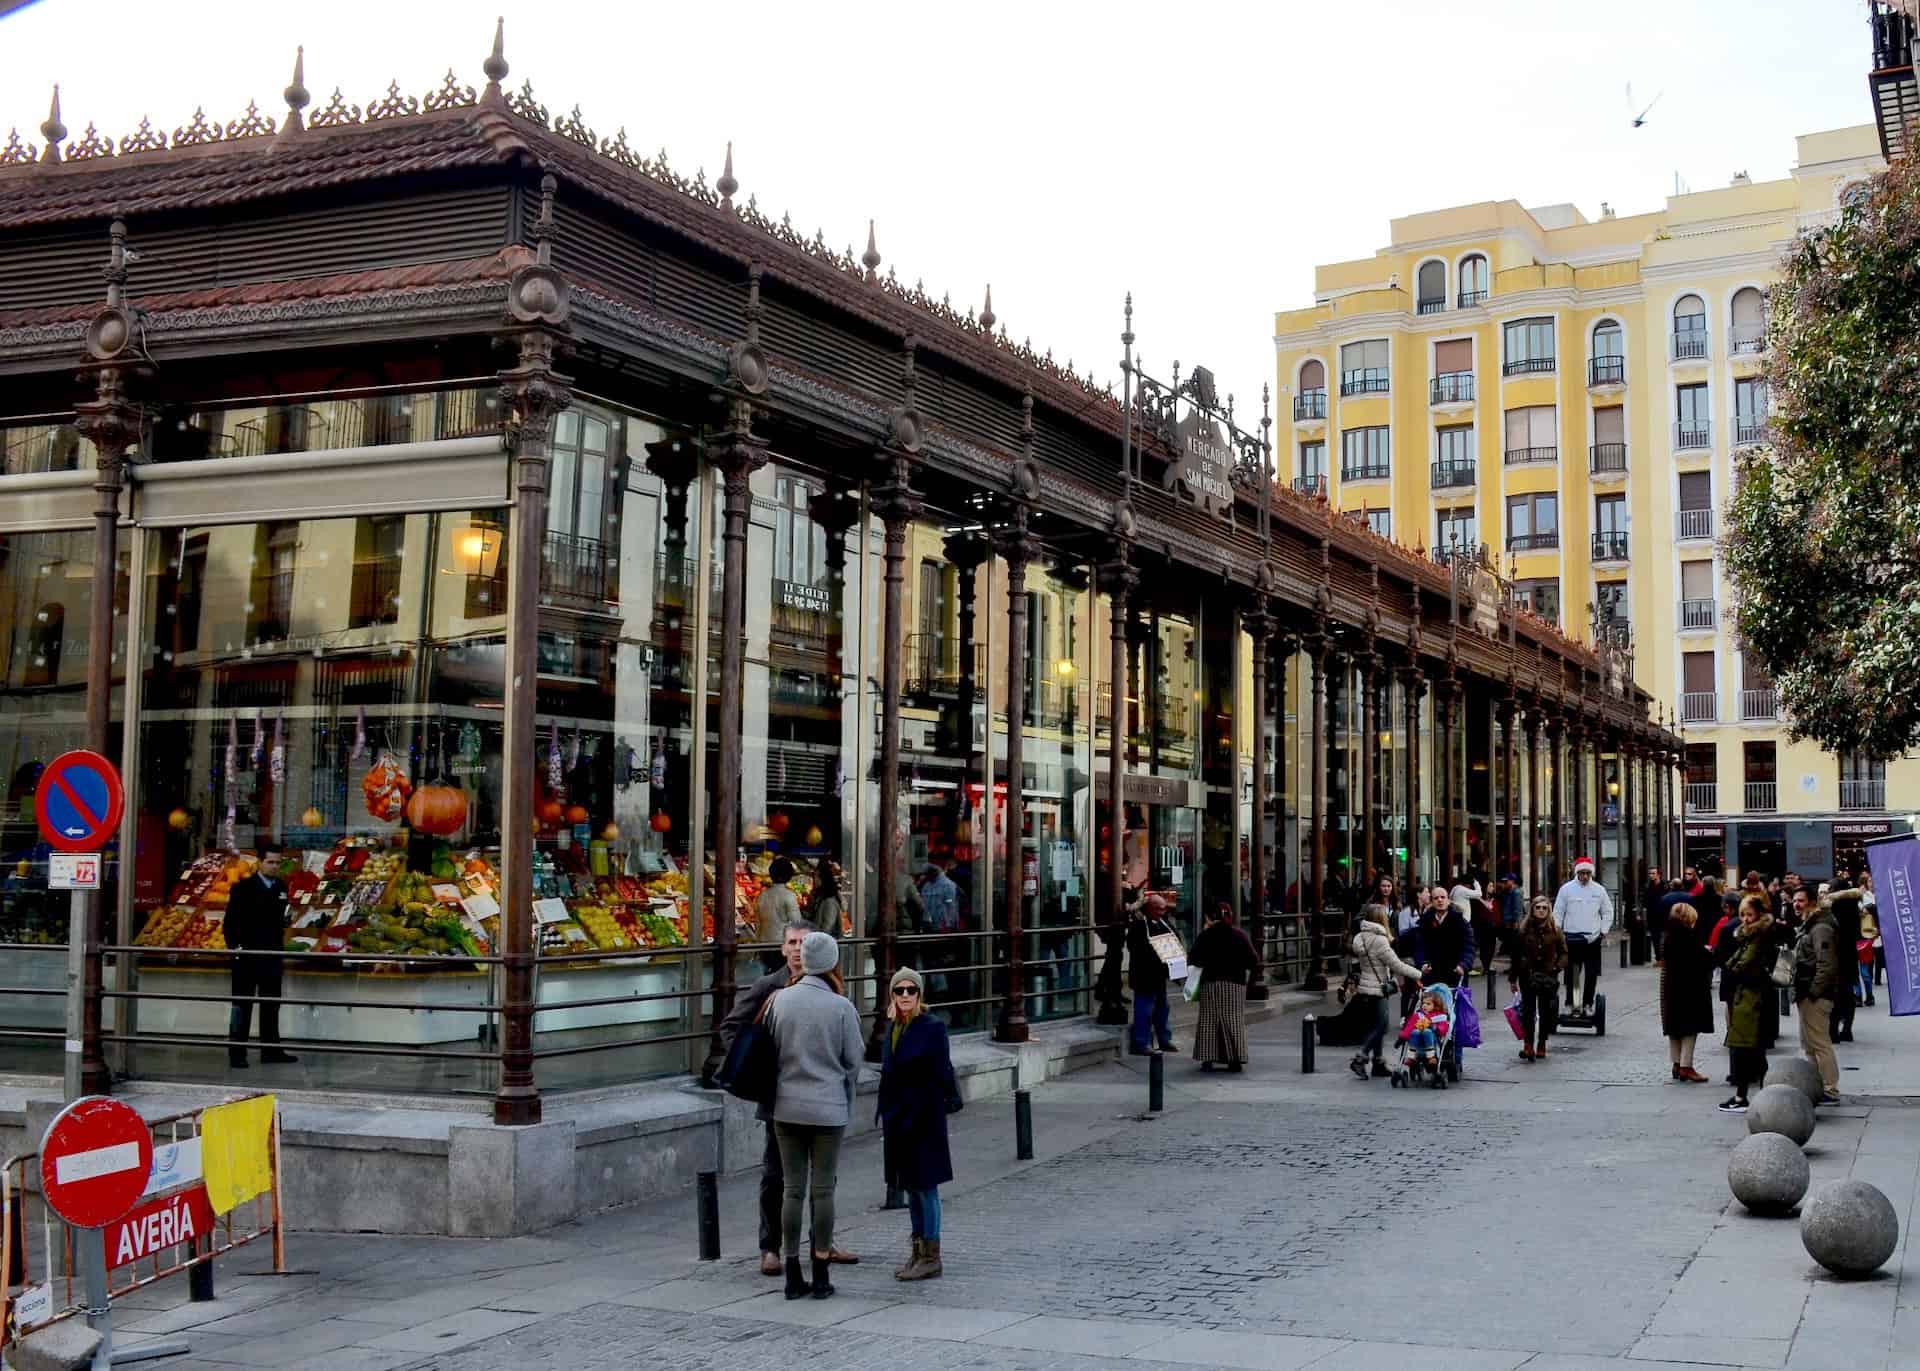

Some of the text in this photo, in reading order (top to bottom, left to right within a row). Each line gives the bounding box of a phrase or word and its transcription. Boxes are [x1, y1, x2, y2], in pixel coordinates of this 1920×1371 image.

[1187, 435, 1226, 467] MERCADO
[1186, 468, 1229, 500] SAN MIGUEL
[1202, 461, 1213, 475] DE
[116, 1195, 195, 1265] AVERÍA
